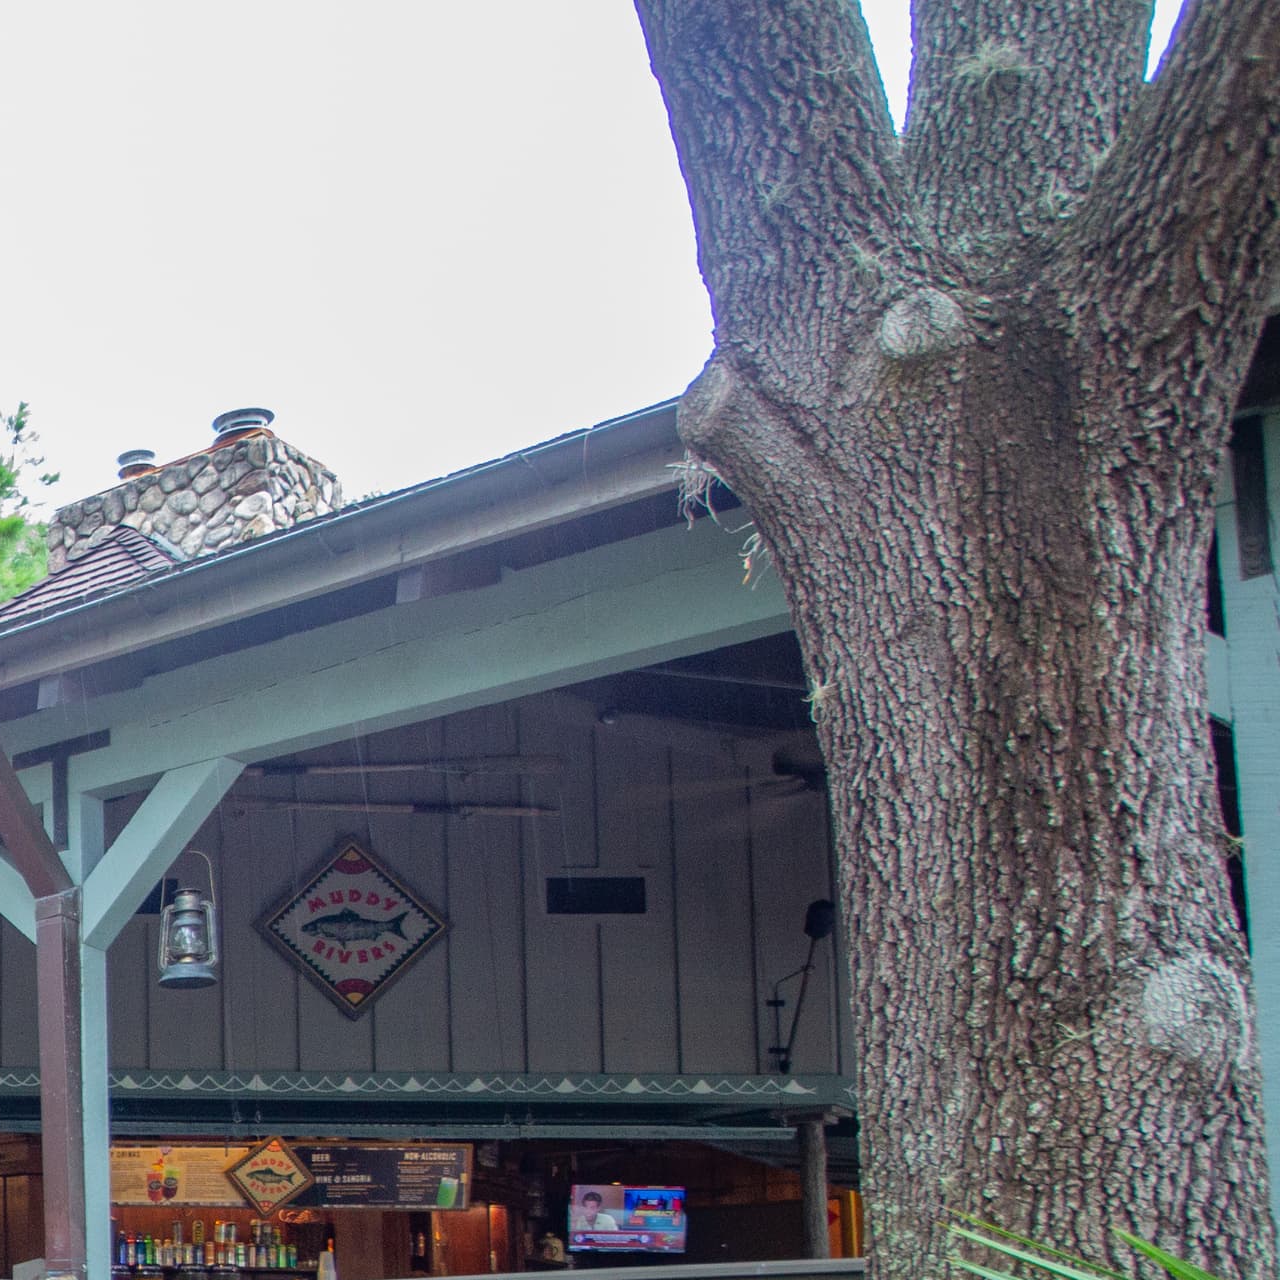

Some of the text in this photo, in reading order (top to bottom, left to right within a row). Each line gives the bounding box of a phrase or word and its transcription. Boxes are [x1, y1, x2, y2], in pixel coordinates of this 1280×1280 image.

[307, 889, 398, 913] MUDDY
[312, 939, 397, 964] RIVERS
[404, 1152, 457, 1161] NON-ALCOHOLIC
[249, 1158, 293, 1171] MUDDY
[249, 1180, 289, 1194] RIVERS
